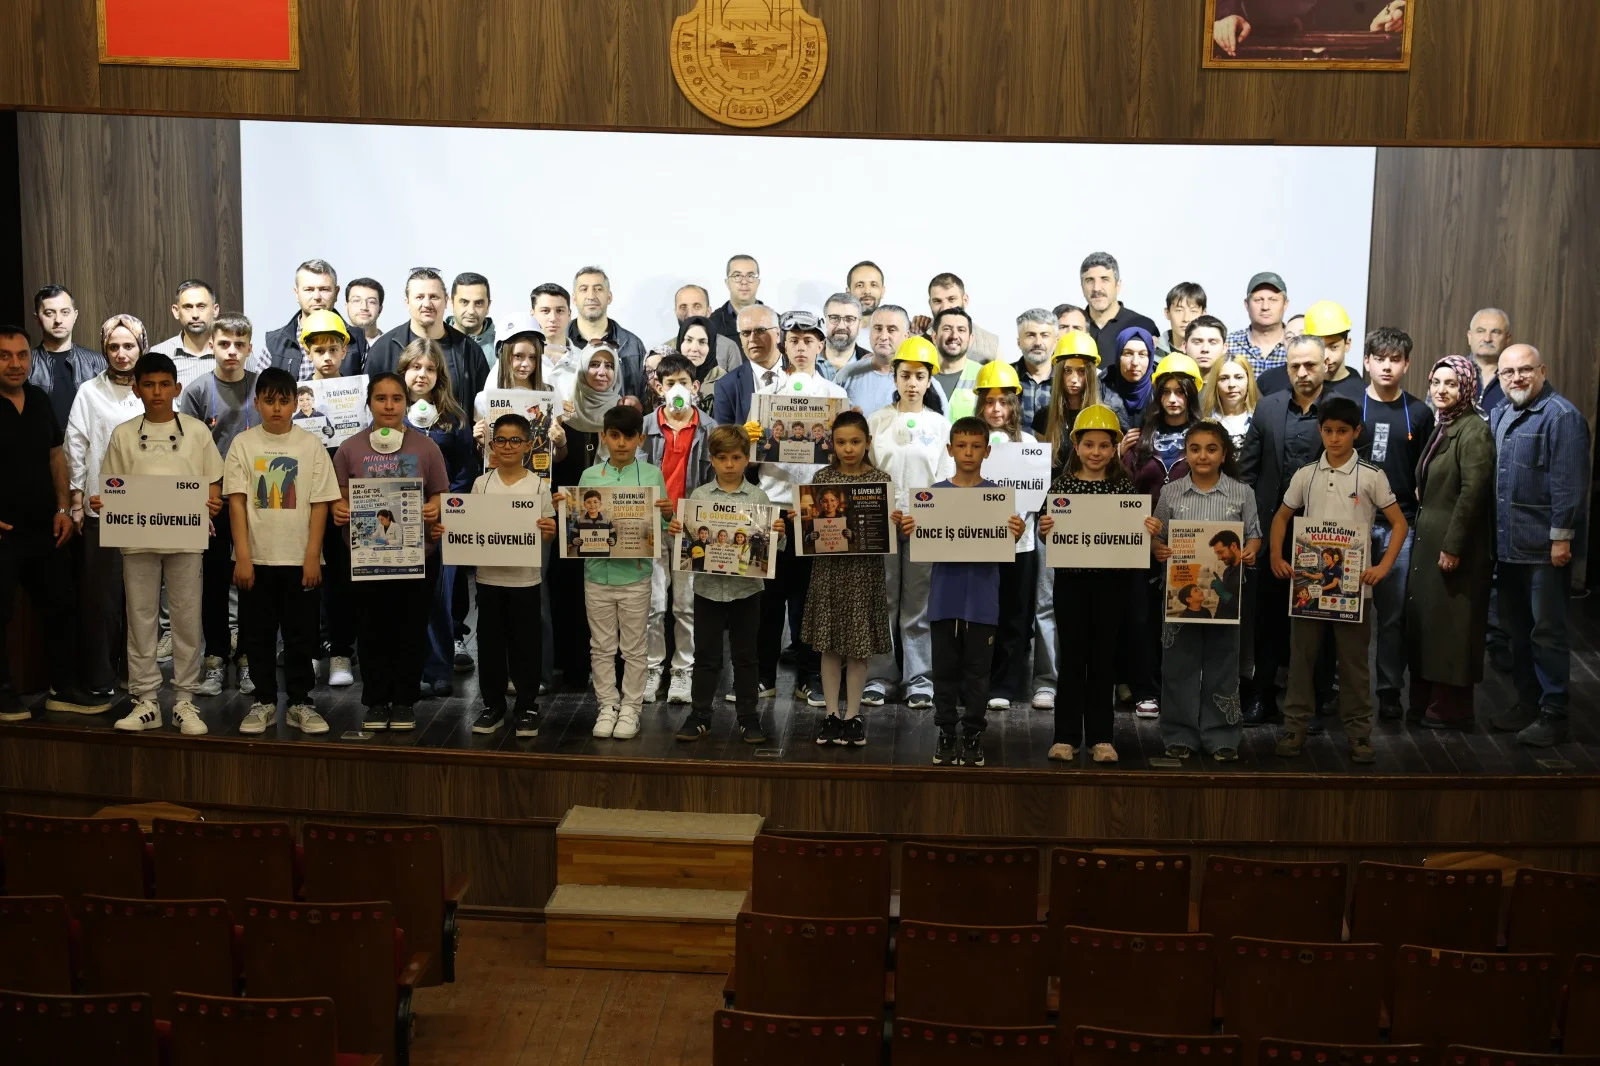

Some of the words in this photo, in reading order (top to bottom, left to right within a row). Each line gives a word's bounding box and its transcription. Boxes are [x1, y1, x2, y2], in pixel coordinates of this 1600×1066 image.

[490, 399, 513, 409] BABA,
[176, 482, 200, 490] ISKO
[998, 478, 1044, 490] GÜVENLİĞİ
[618, 492, 646, 500] GÜVENLİĞİ
[851, 487, 856, 496] İŞ
[858, 486, 882, 494] GÜVENLİĞİ
[983, 494, 1006, 502] ISKO
[512, 500, 534, 508] ISKO
[712, 502, 737, 513] ÖNCE
[1120, 500, 1142, 508] ISKO
[106, 512, 134, 525] ÖNCE
[136, 512, 147, 528] İŞ
[150, 512, 201, 527] GÜVENLİĞİ
[700, 512, 707, 520] İŞ
[916, 526, 942, 539] ÖNCE
[945, 526, 955, 542] İŞ
[958, 526, 1008, 539] GÜVENLİĞİ
[1305, 526, 1356, 538] KULAKLIĞINI
[448, 532, 474, 544] ÖNCE
[476, 532, 486, 547] İŞ
[488, 532, 536, 546] GÜVENLİĞİ
[1052, 532, 1079, 544] ÖNCE
[1082, 532, 1091, 548] İŞ
[1094, 532, 1143, 546] GÜVENLİĞİ
[1311, 534, 1352, 544] KULLAN!
